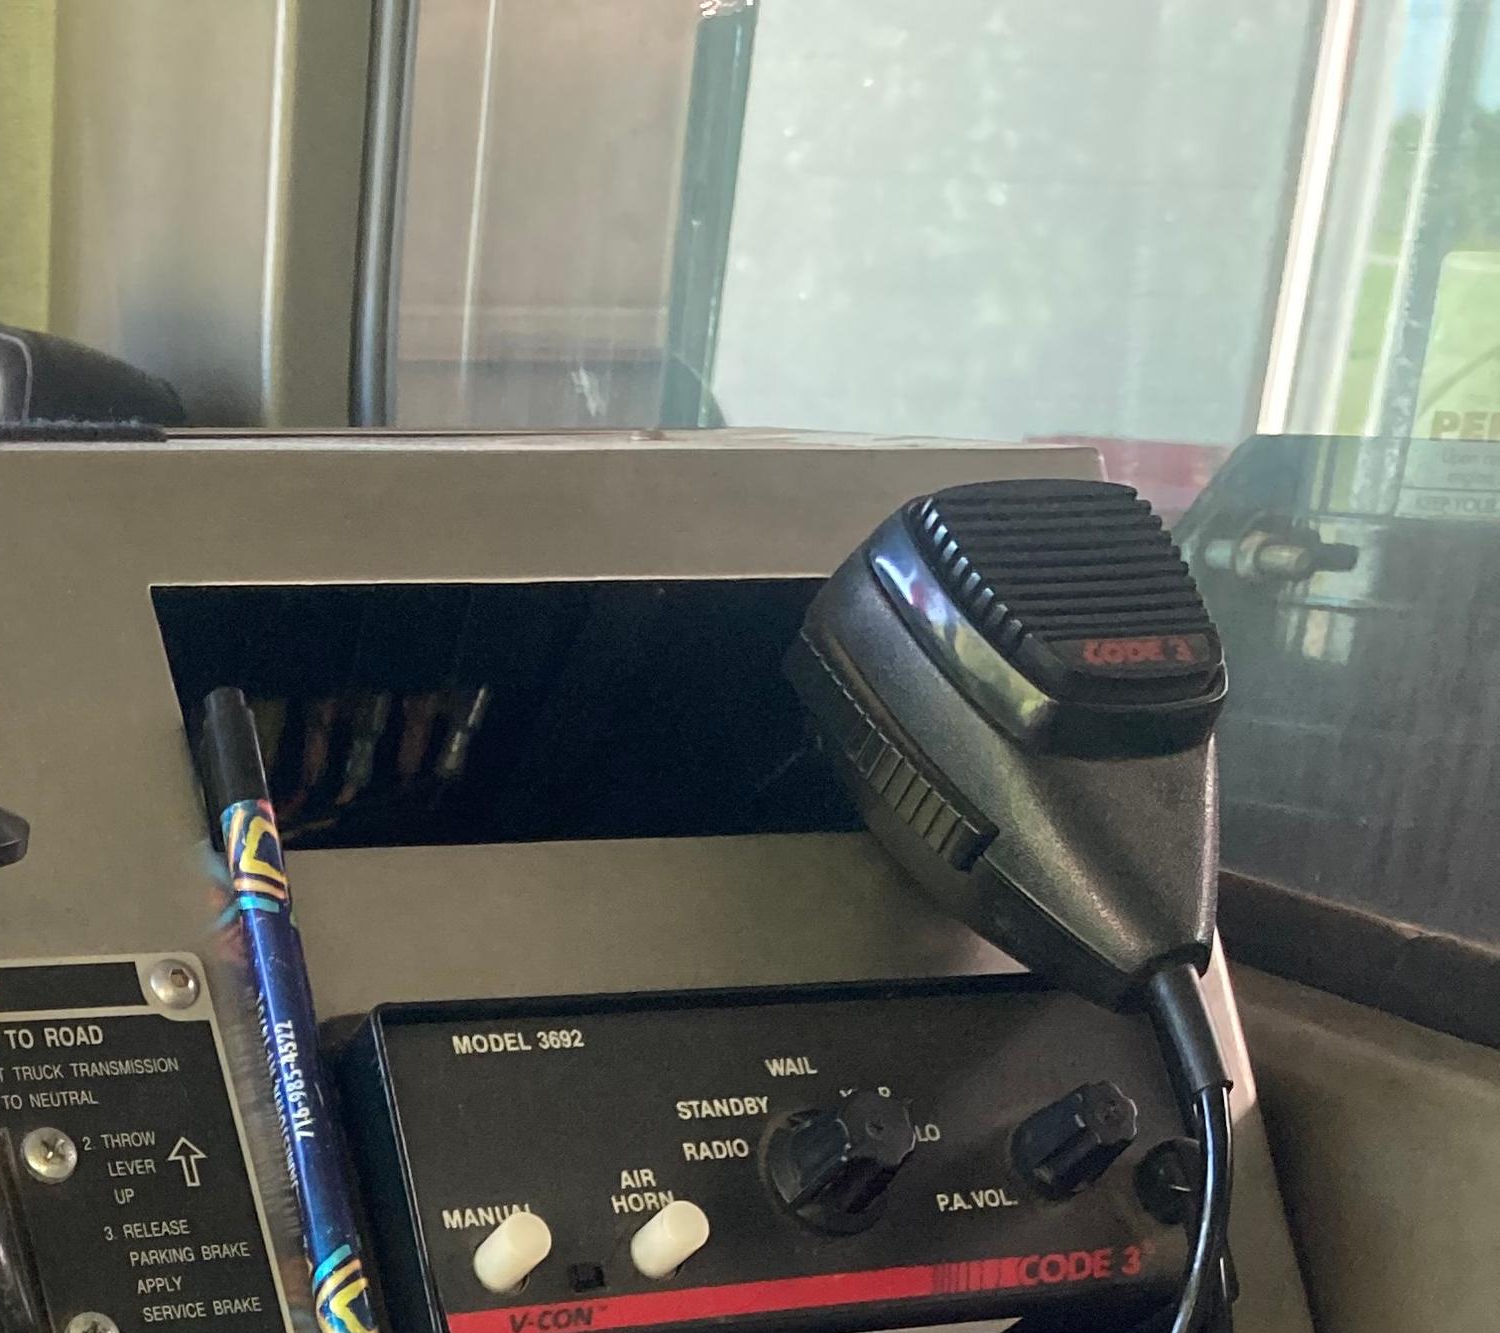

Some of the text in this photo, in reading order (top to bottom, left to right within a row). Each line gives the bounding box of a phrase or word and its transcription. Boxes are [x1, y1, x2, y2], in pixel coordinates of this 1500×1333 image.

[1083, 638, 1164, 666] CODE
[4, 1029, 33, 1049] TO
[44, 1026, 103, 1047] ROAD
[452, 1030, 584, 1054] MODEL 3692
[12, 1063, 64, 1081] TRUCK
[69, 1059, 179, 1078] TRANSMISSION
[765, 1056, 818, 1077] WAIL
[274, 1020, 316, 1140] 716-985-4522
[1, 1091, 99, 1110] TO NEUTRAL
[676, 1096, 769, 1120] STANDBY
[101, 1132, 155, 1148] THROW
[683, 1139, 749, 1161] RADIO
[108, 1160, 155, 1177] LEVER
[620, 1168, 656, 1189] AIR
[114, 1188, 134, 1204] UP
[611, 1190, 674, 1214] HORN
[123, 1220, 189, 1239] RELEASE
[130, 1243, 250, 1266] PARKING BRAKE
[1019, 1246, 1141, 1286] CODE 3
[137, 1277, 182, 1294] APPLY
[143, 1298, 262, 1322] SERVICE BRAKE
[509, 1306, 594, 1333] V-CON
